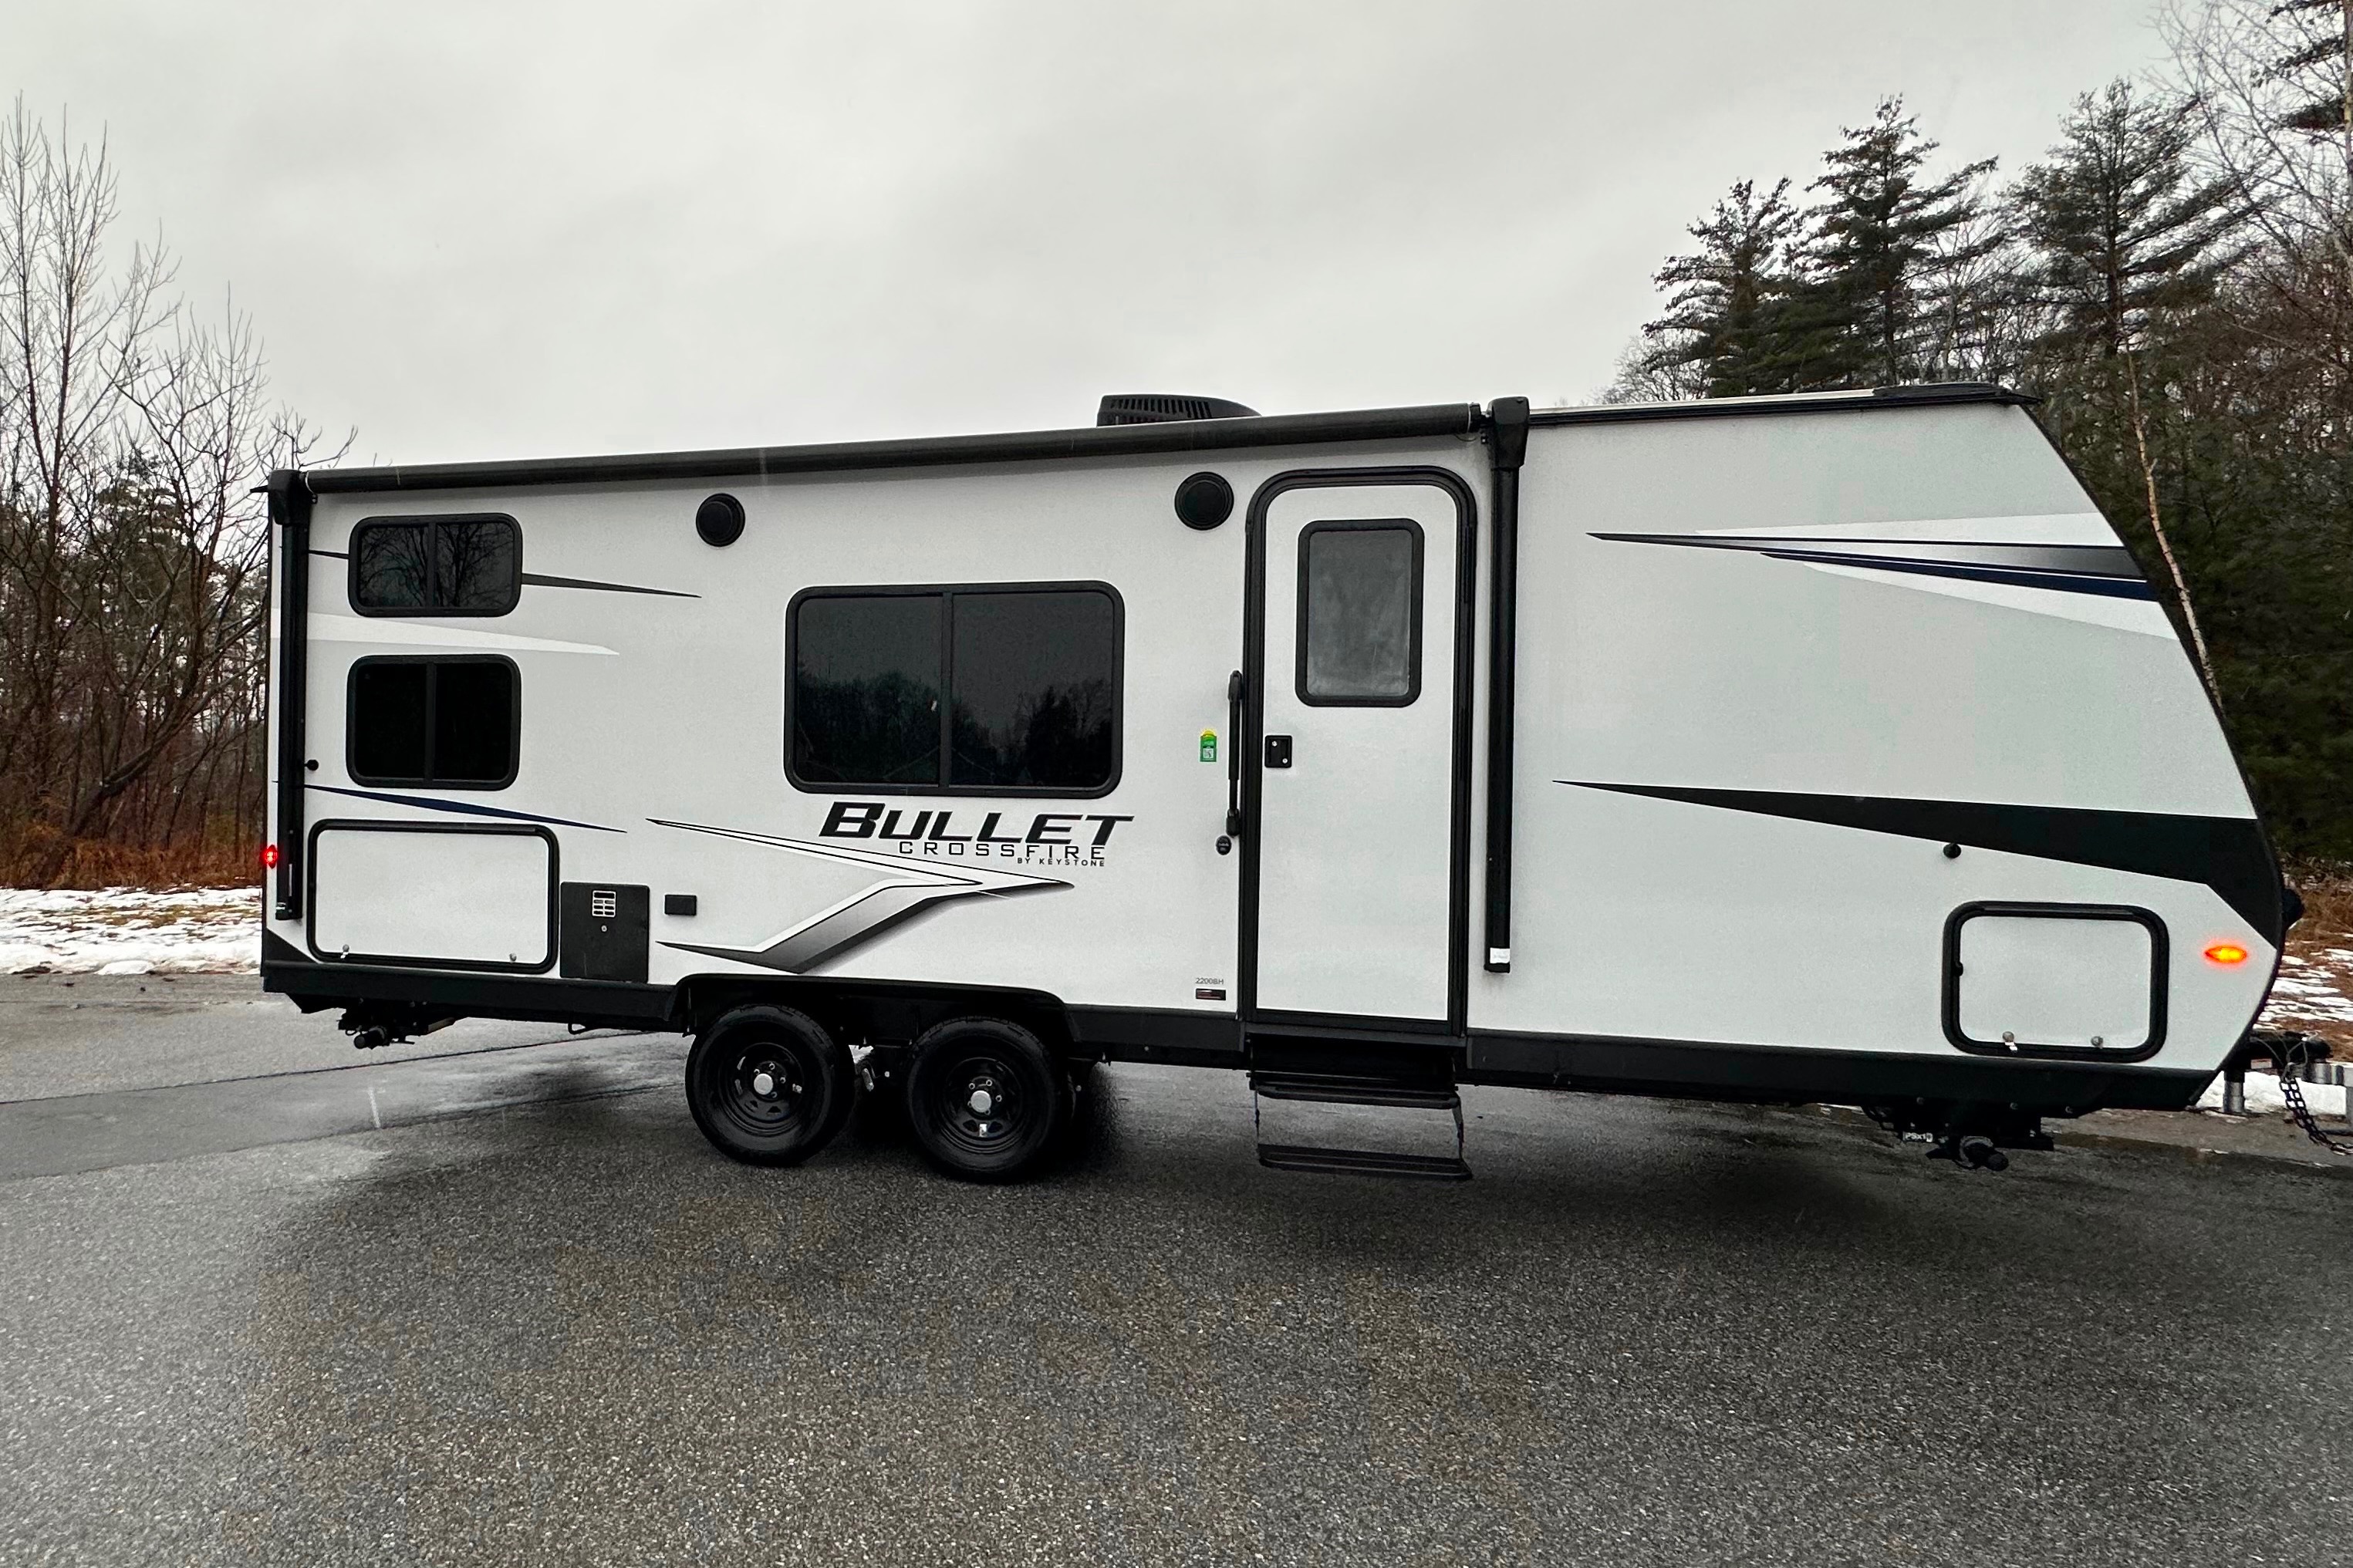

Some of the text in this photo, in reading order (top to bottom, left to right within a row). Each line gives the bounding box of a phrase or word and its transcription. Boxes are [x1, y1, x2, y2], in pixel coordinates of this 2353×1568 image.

[819, 801, 1135, 845] BULLET
[899, 841, 1105, 860] CROSSFIRE
[1038, 858, 1105, 867] KEYSTONE
